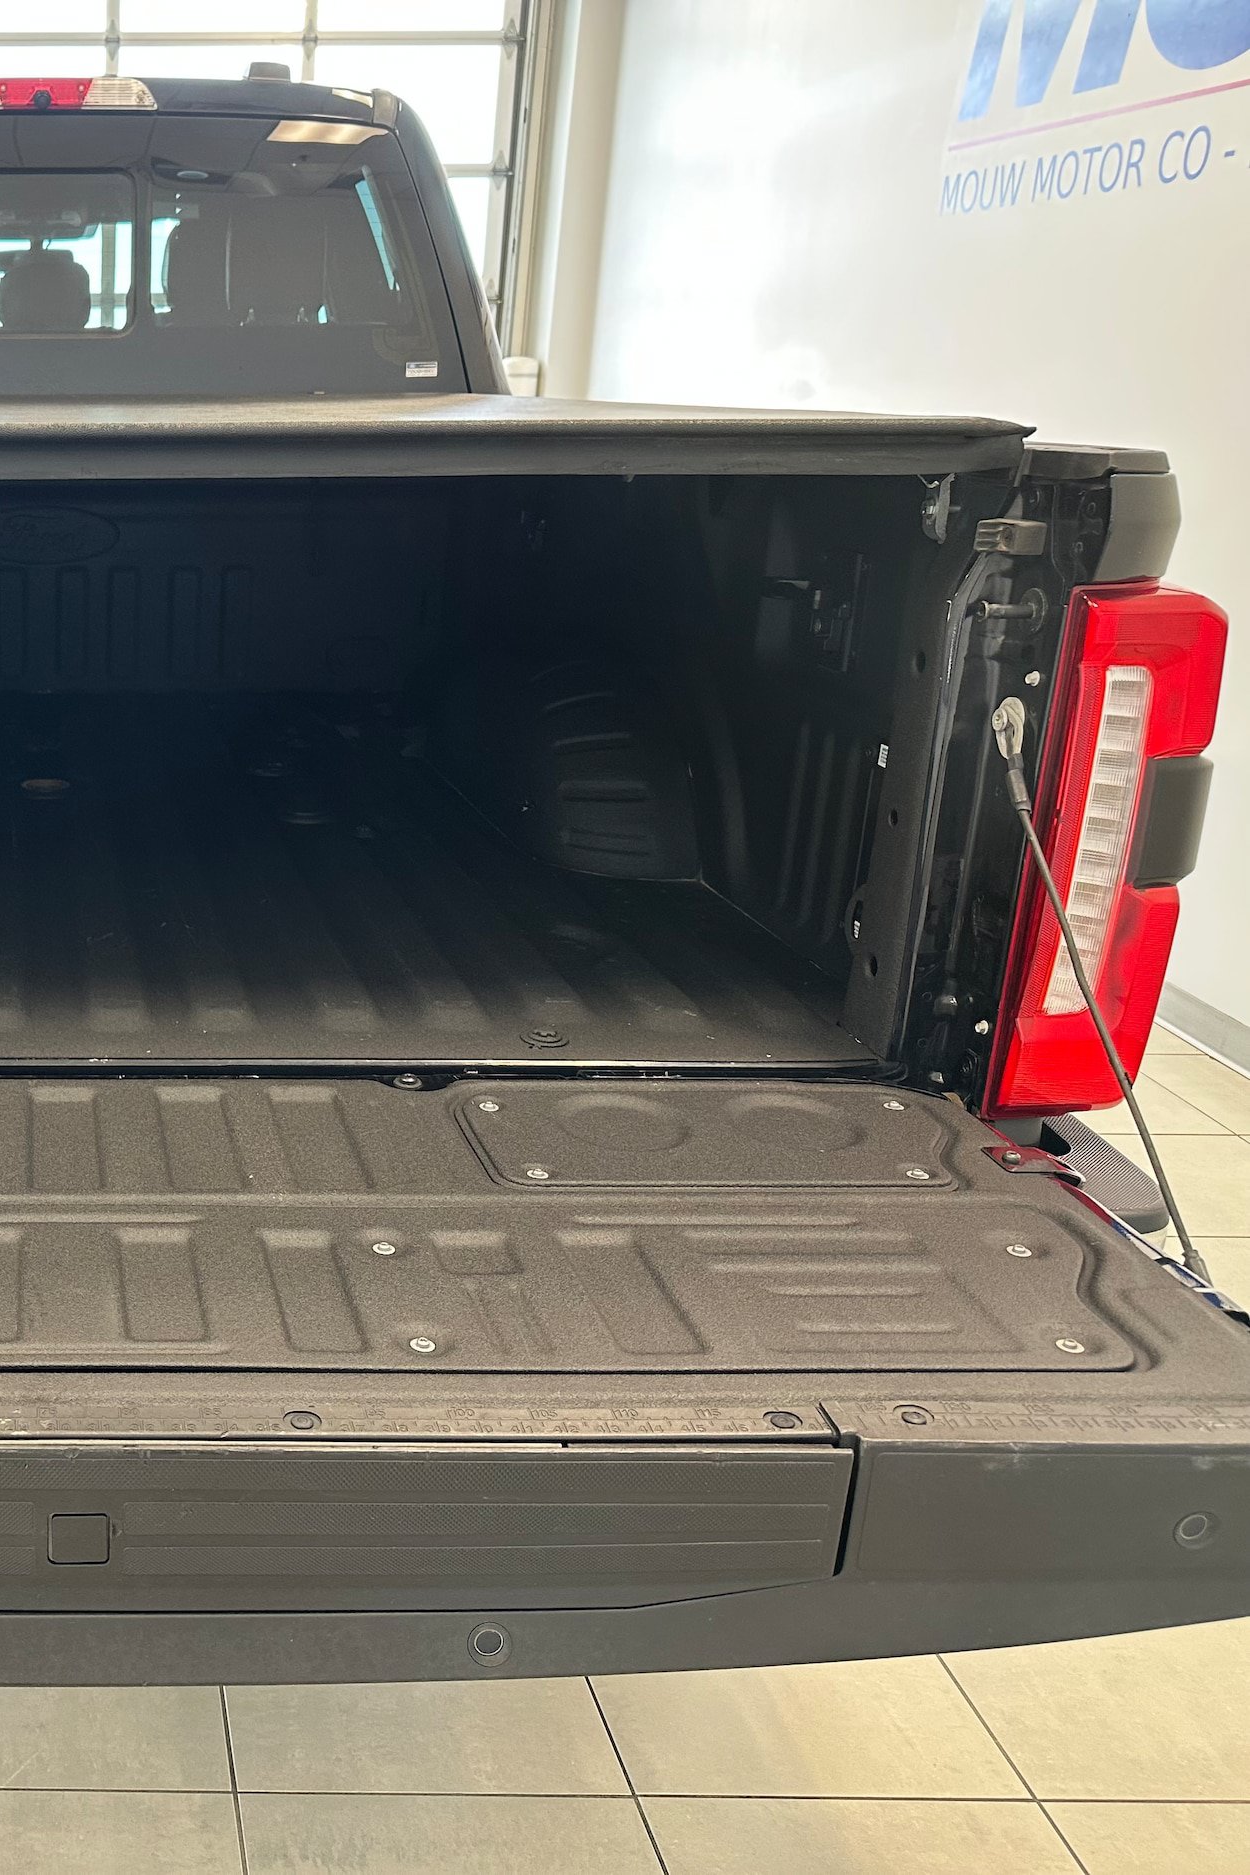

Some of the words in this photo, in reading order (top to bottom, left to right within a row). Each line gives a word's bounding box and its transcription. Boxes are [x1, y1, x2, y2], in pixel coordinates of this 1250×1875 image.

[940, 160, 1026, 217] MOUW
[1031, 138, 1146, 202] MOTOR
[1158, 125, 1212, 184] CO
